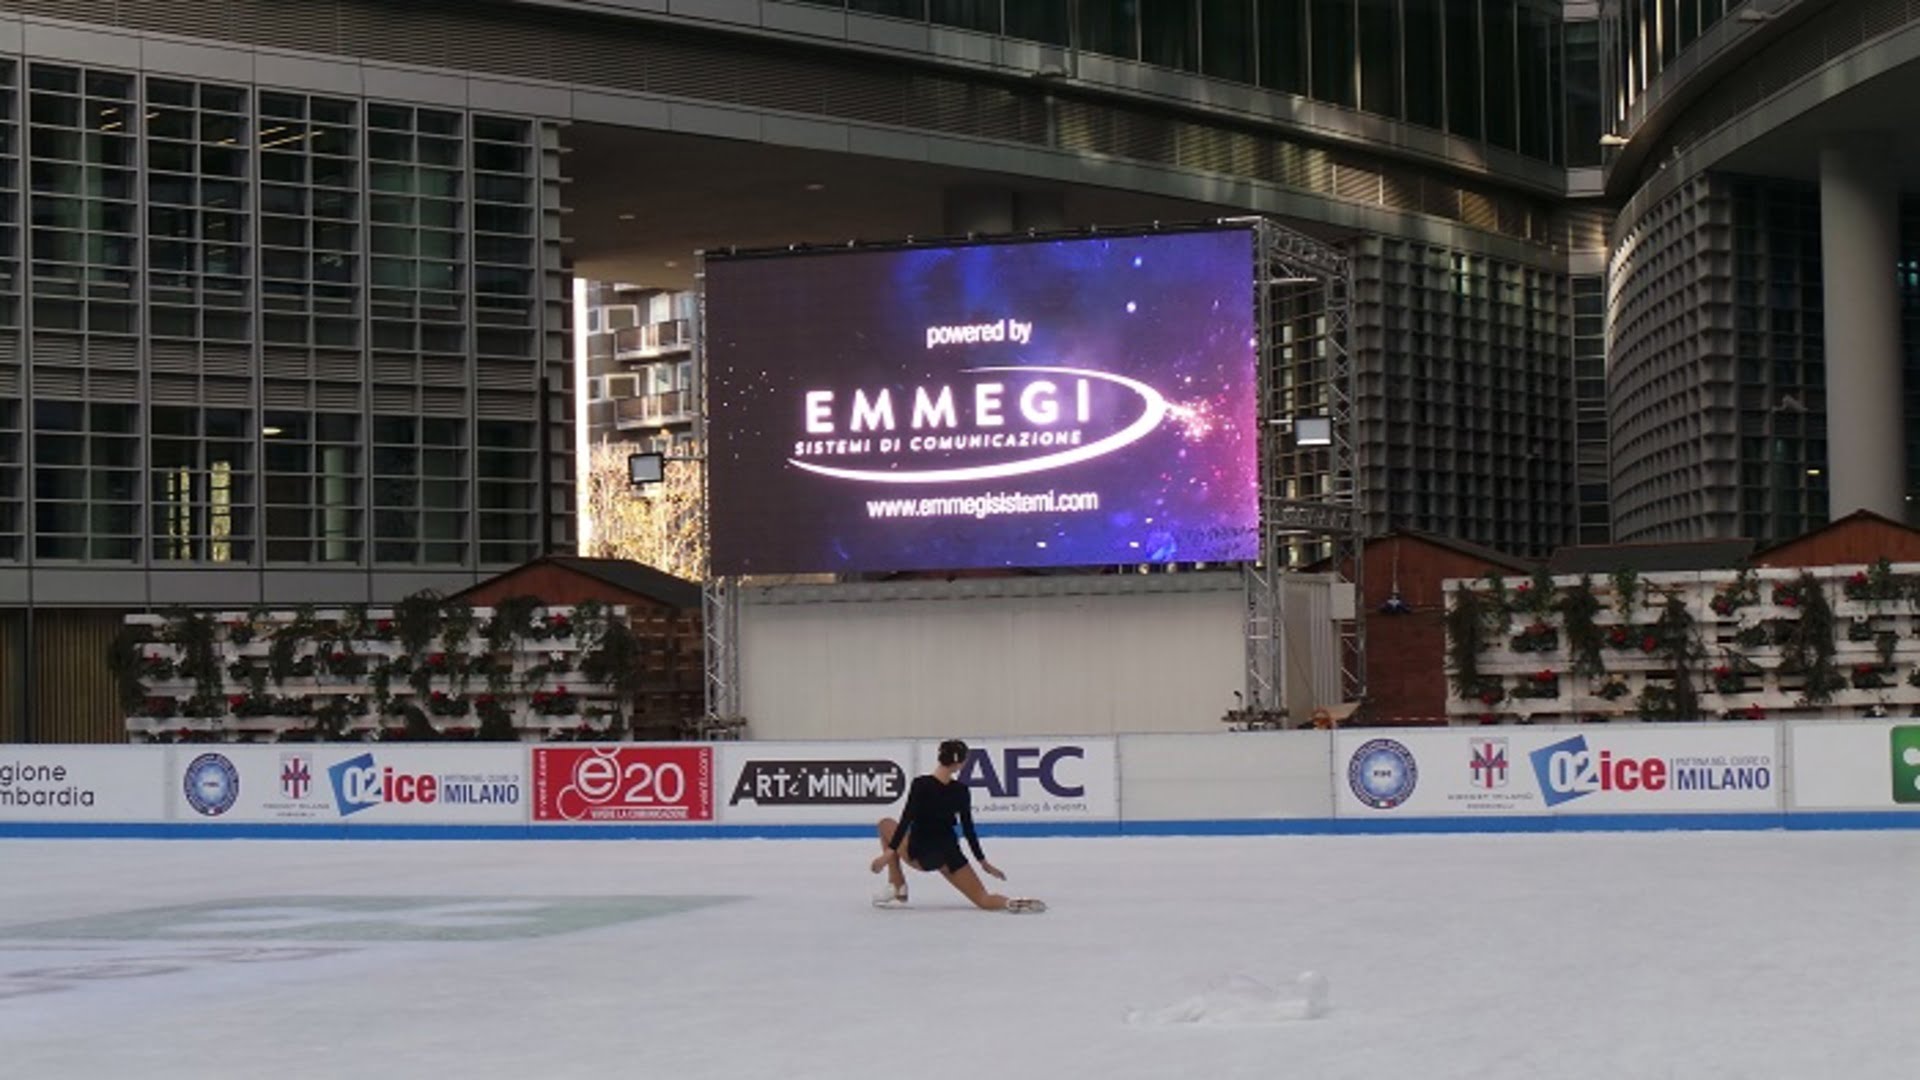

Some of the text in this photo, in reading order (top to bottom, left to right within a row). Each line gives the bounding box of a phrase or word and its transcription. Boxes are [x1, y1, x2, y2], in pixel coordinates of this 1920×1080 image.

[926, 319, 1032, 349] powered by
[804, 378, 1090, 433] EMMEGI
[795, 429, 1082, 456] SISTEMI DI COMUNICAZIONE
[865, 489, 1099, 519] www.emmegisistemi.com
[0, 761, 67, 787] gione
[807, 768, 899, 798] MINIME
[957, 746, 1085, 798] AFC
[1678, 767, 1770, 790] MILANO
[444, 784, 519, 804] MILANO
